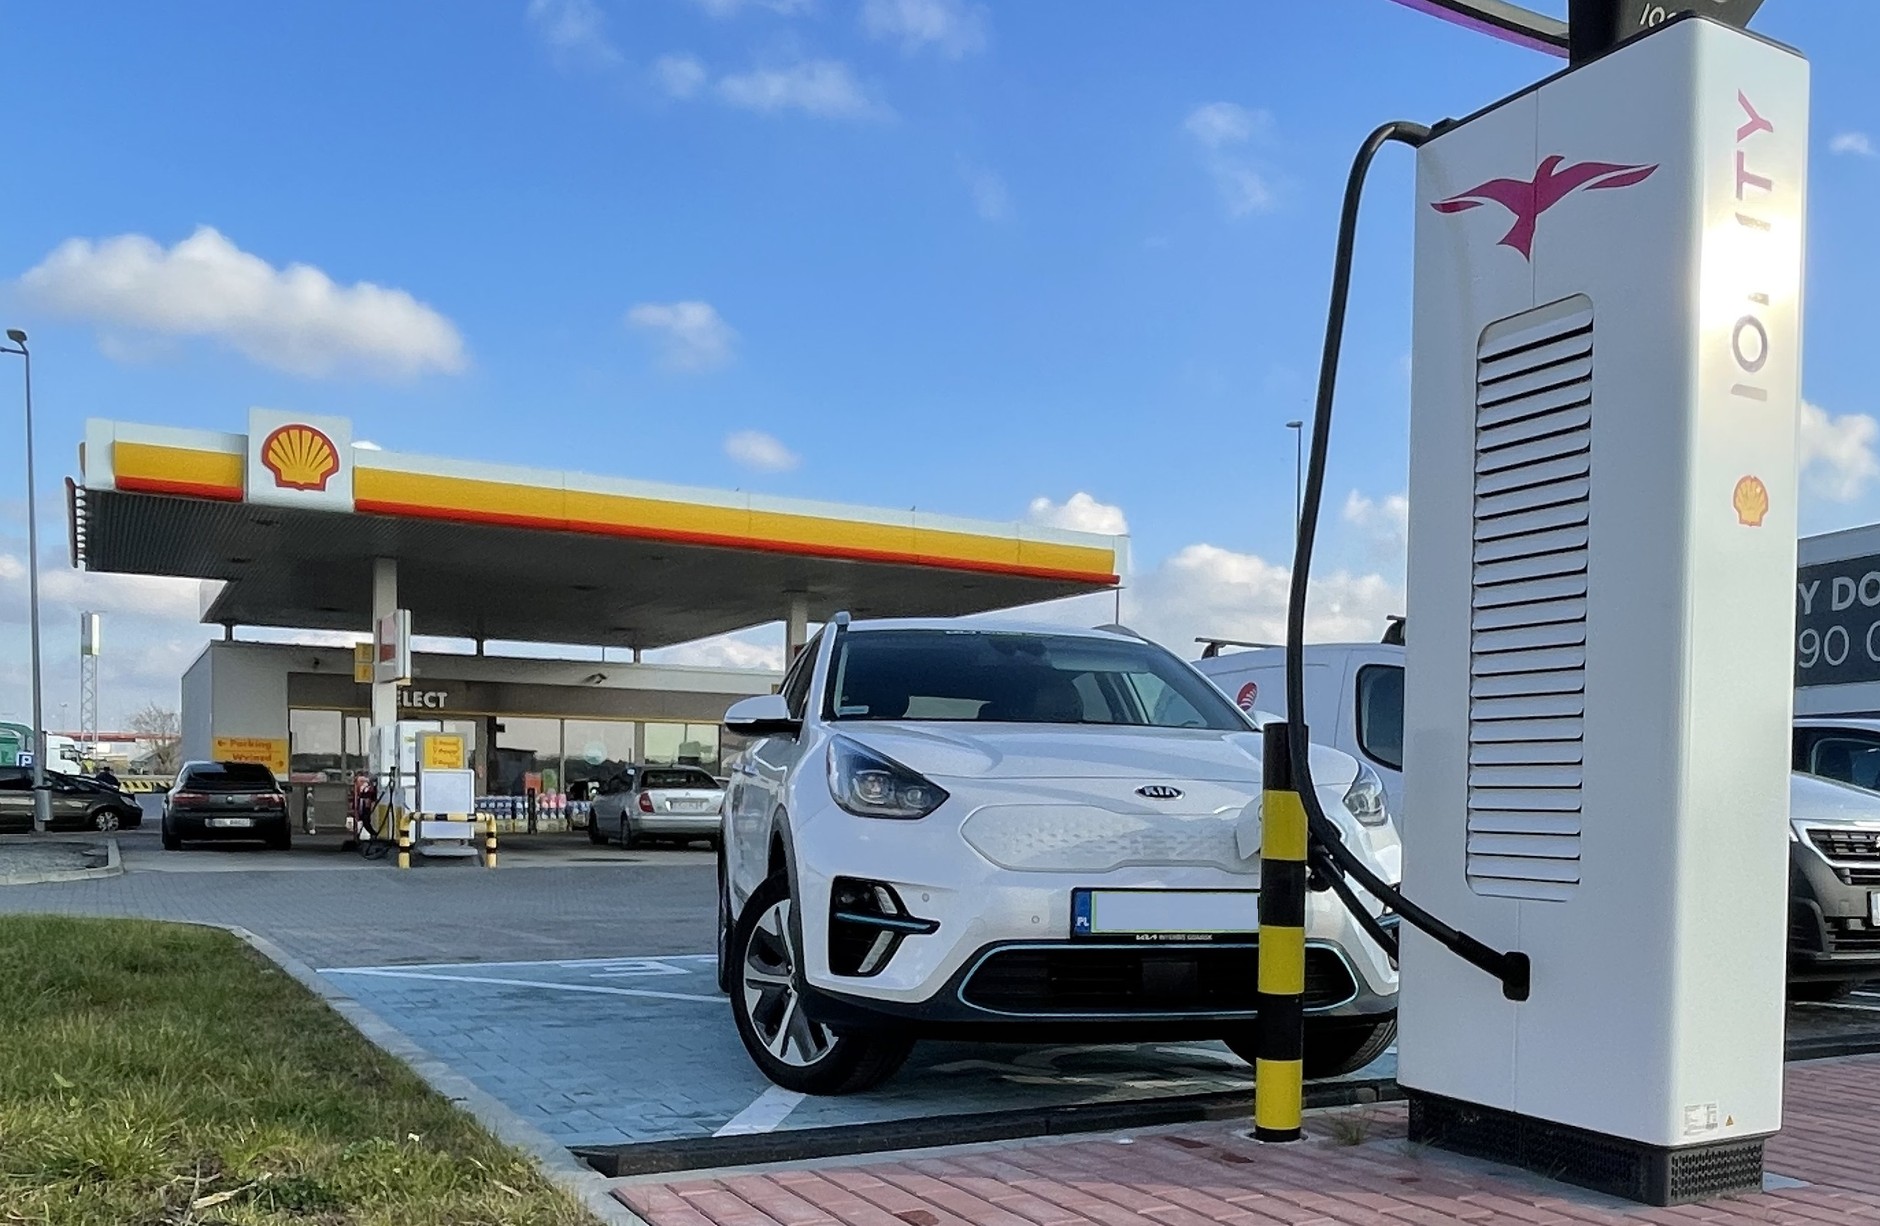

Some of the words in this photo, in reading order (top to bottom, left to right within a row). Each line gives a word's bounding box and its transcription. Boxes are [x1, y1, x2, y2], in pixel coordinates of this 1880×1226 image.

[1730, 87, 1774, 402] IOITY
[1797, 579, 1821, 615] Y
[1798, 625, 1850, 668] 90
[1144, 786, 1178, 797] KIA
[1076, 916, 1090, 927] PL
